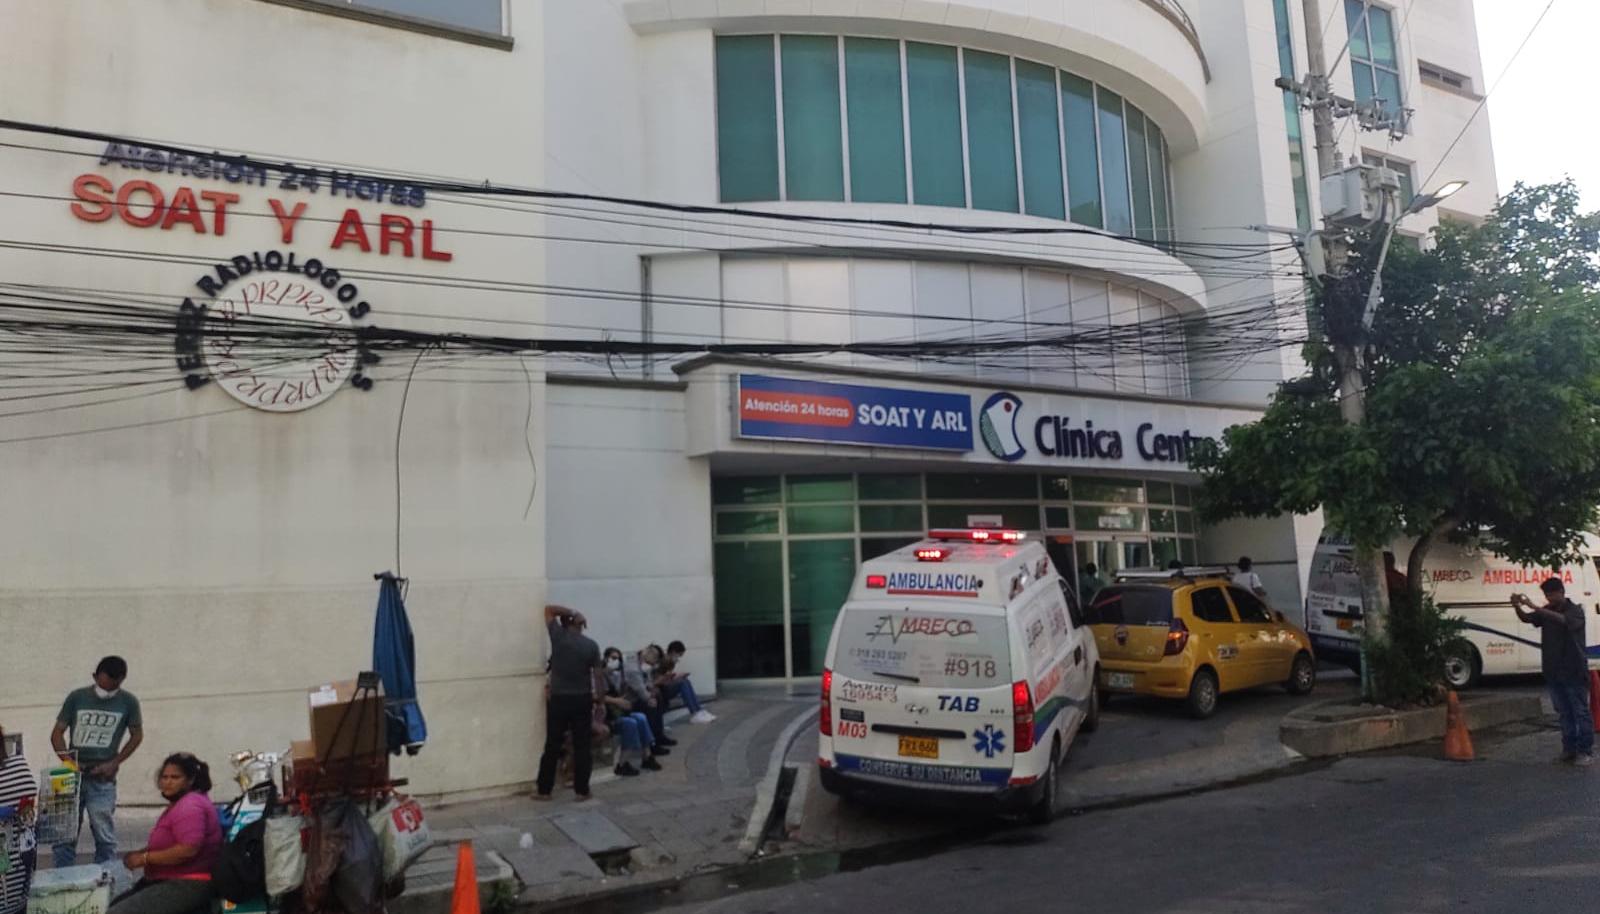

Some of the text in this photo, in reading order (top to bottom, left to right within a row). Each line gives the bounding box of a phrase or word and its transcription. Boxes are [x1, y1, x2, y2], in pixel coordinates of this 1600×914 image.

[70, 173, 453, 262] SOAT Y ARL
[195, 250, 371, 319] RADIOLOGOS
[744, 397, 849, 418] Atención 24 horas
[858, 404, 967, 432] SOAT Y ARL
[1034, 415, 1124, 460] Clínica
[888, 573, 978, 591] AMBULANCIA
[1482, 569, 1573, 584] AMBULANIA
[944, 659, 996, 678] #918
[938, 695, 980, 712] TAB
[859, 759, 909, 777] CONSERVE
[926, 766, 983, 783] DISTANCIA
